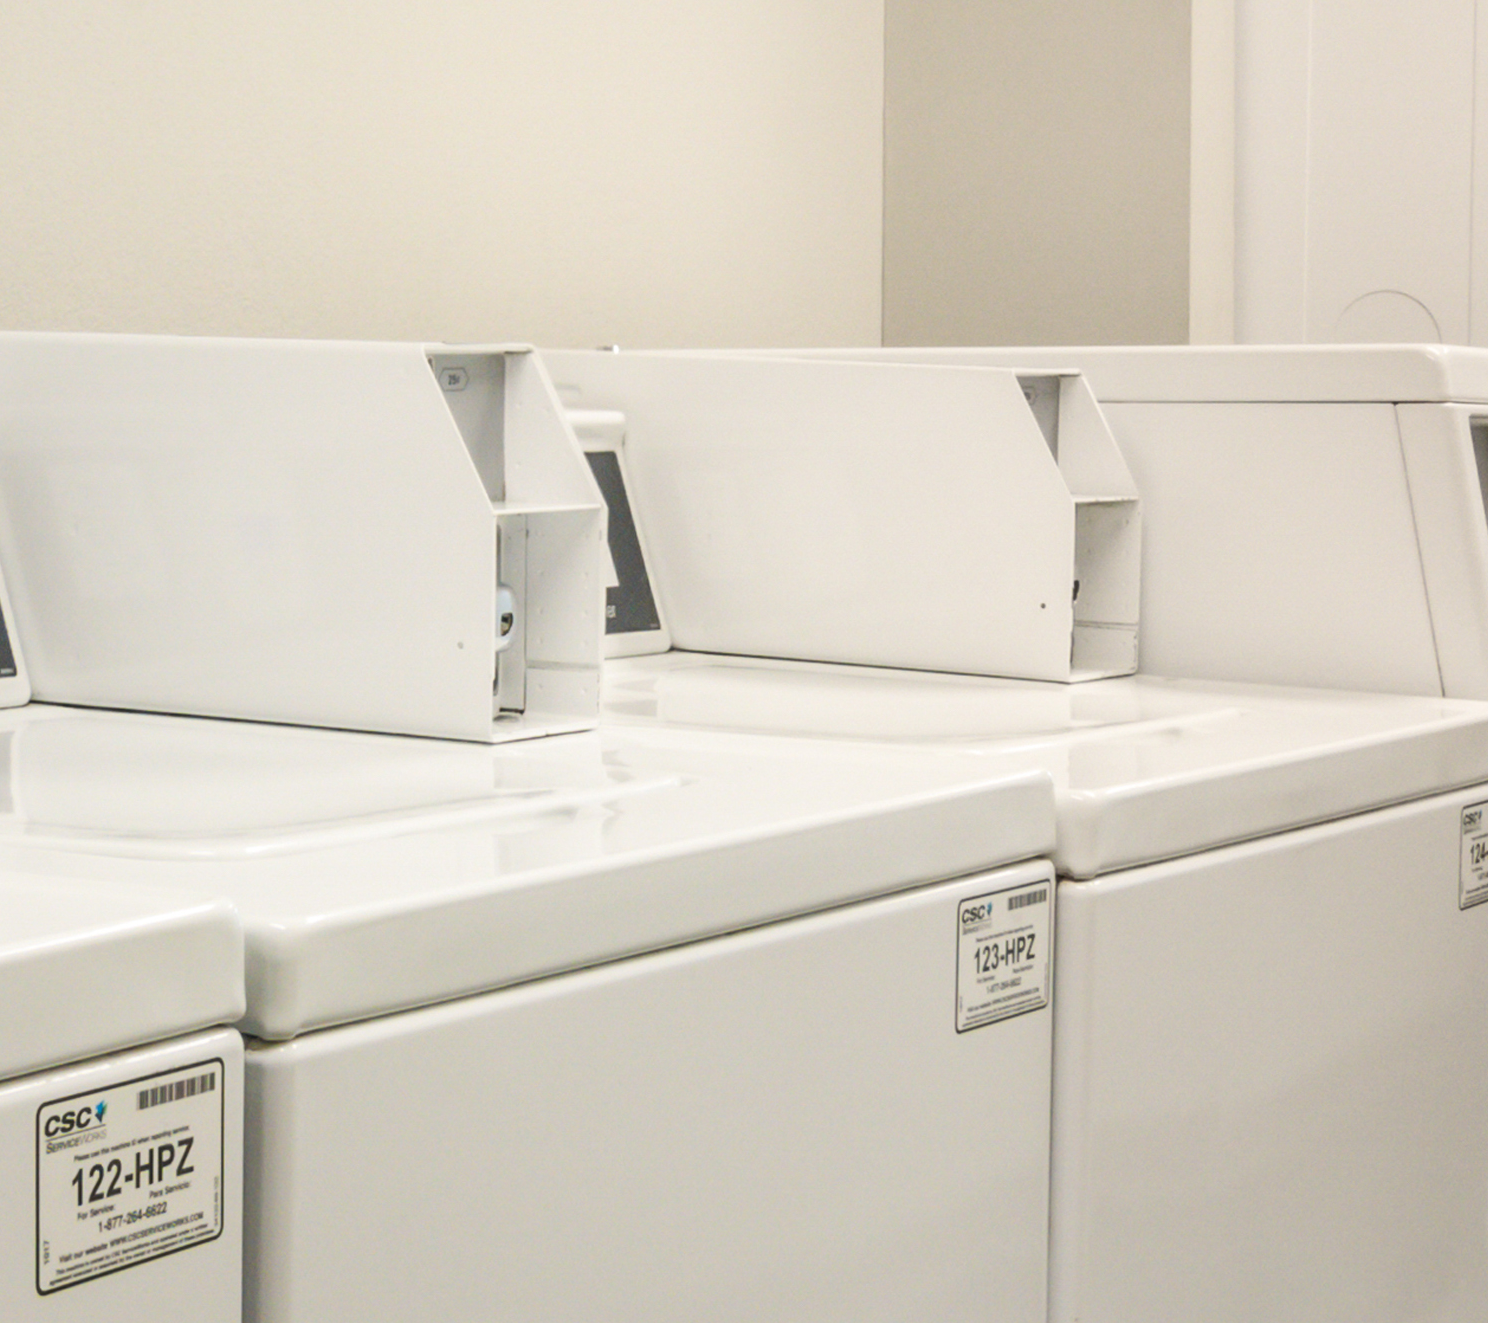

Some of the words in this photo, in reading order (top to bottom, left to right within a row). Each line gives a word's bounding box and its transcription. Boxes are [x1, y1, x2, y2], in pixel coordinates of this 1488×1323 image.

[961, 904, 986, 924] CSC
[974, 933, 1036, 974] 123-HPZ
[44, 1106, 92, 1137] CSC
[72, 1136, 194, 1206] 122-HPZ
